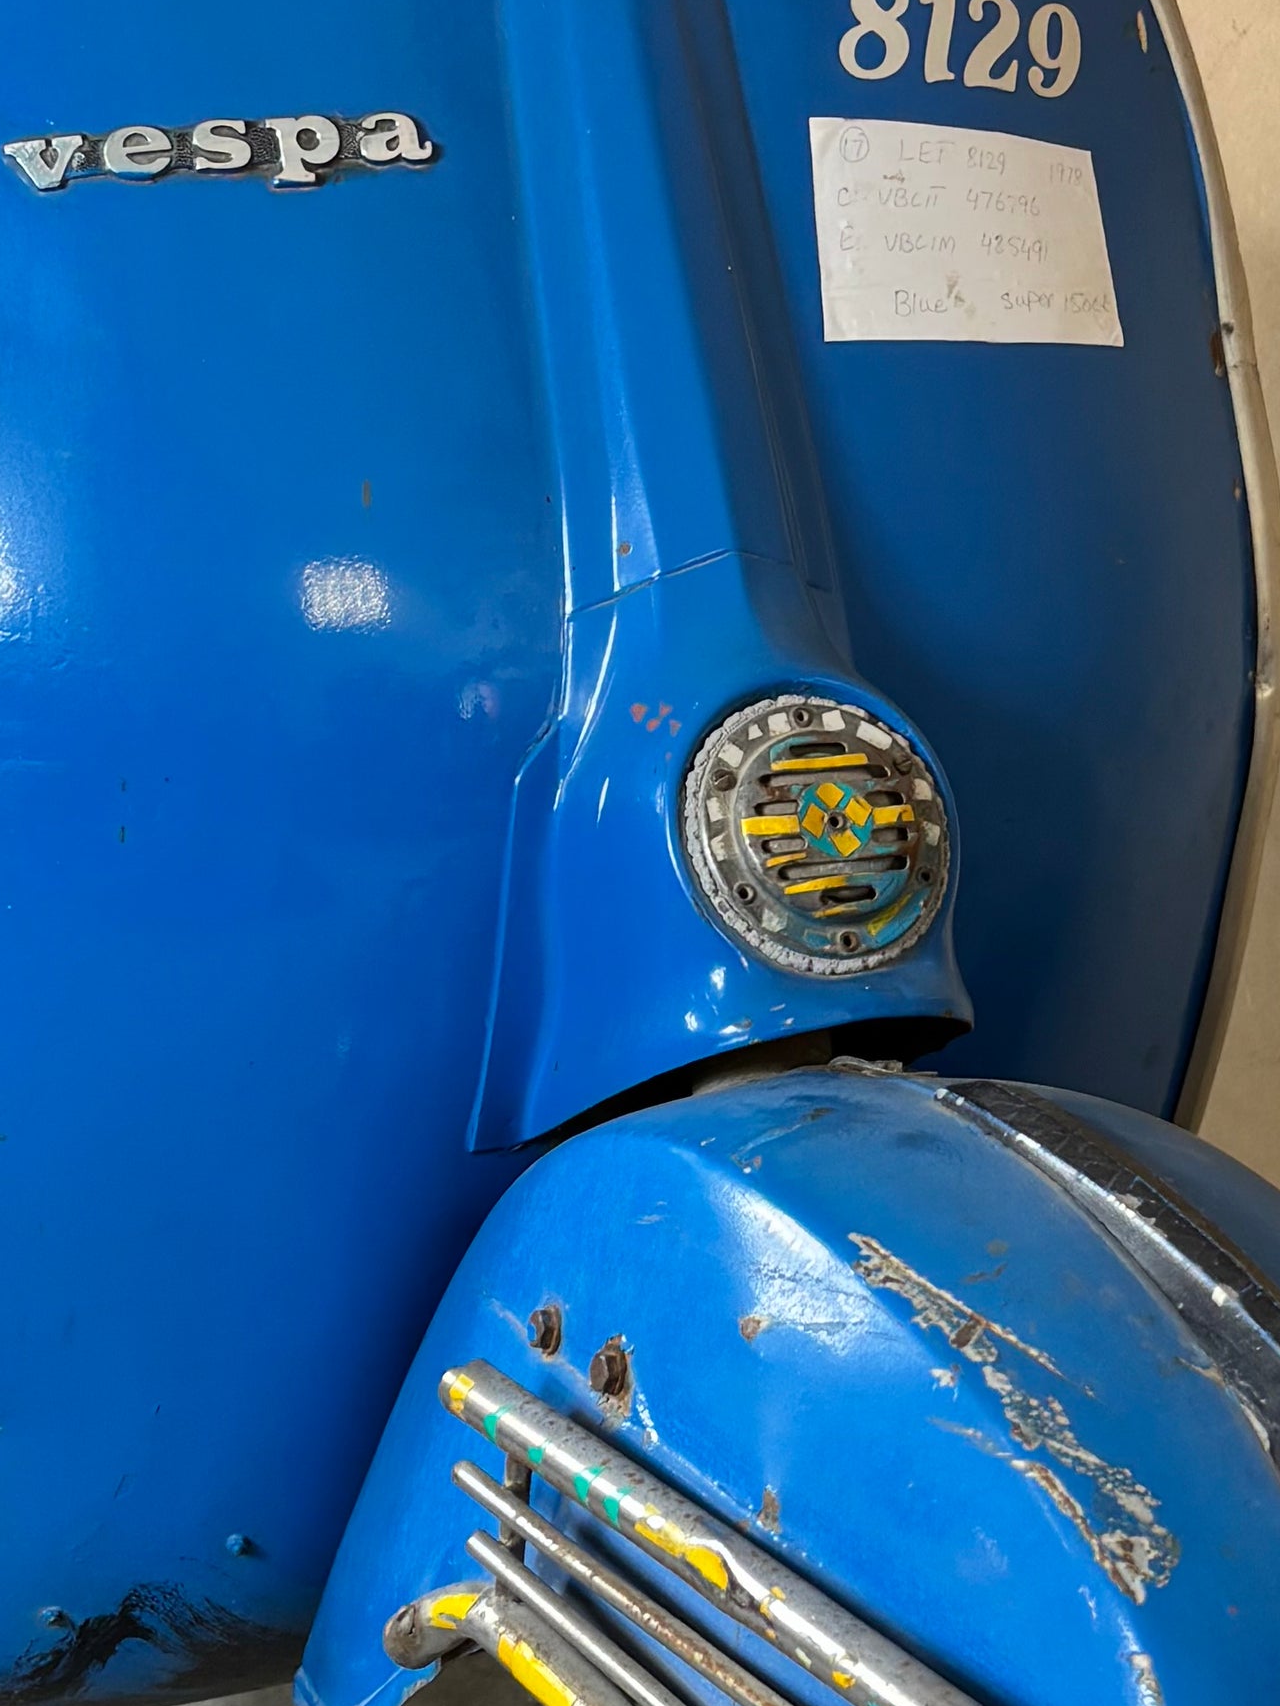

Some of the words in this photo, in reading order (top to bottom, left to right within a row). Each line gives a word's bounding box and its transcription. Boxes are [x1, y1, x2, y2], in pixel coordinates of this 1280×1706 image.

[2, 111, 434, 191] vespa
[898, 139, 956, 164] LET
[966, 146, 1008, 176] 8129
[894, 288, 949, 318] Blue
